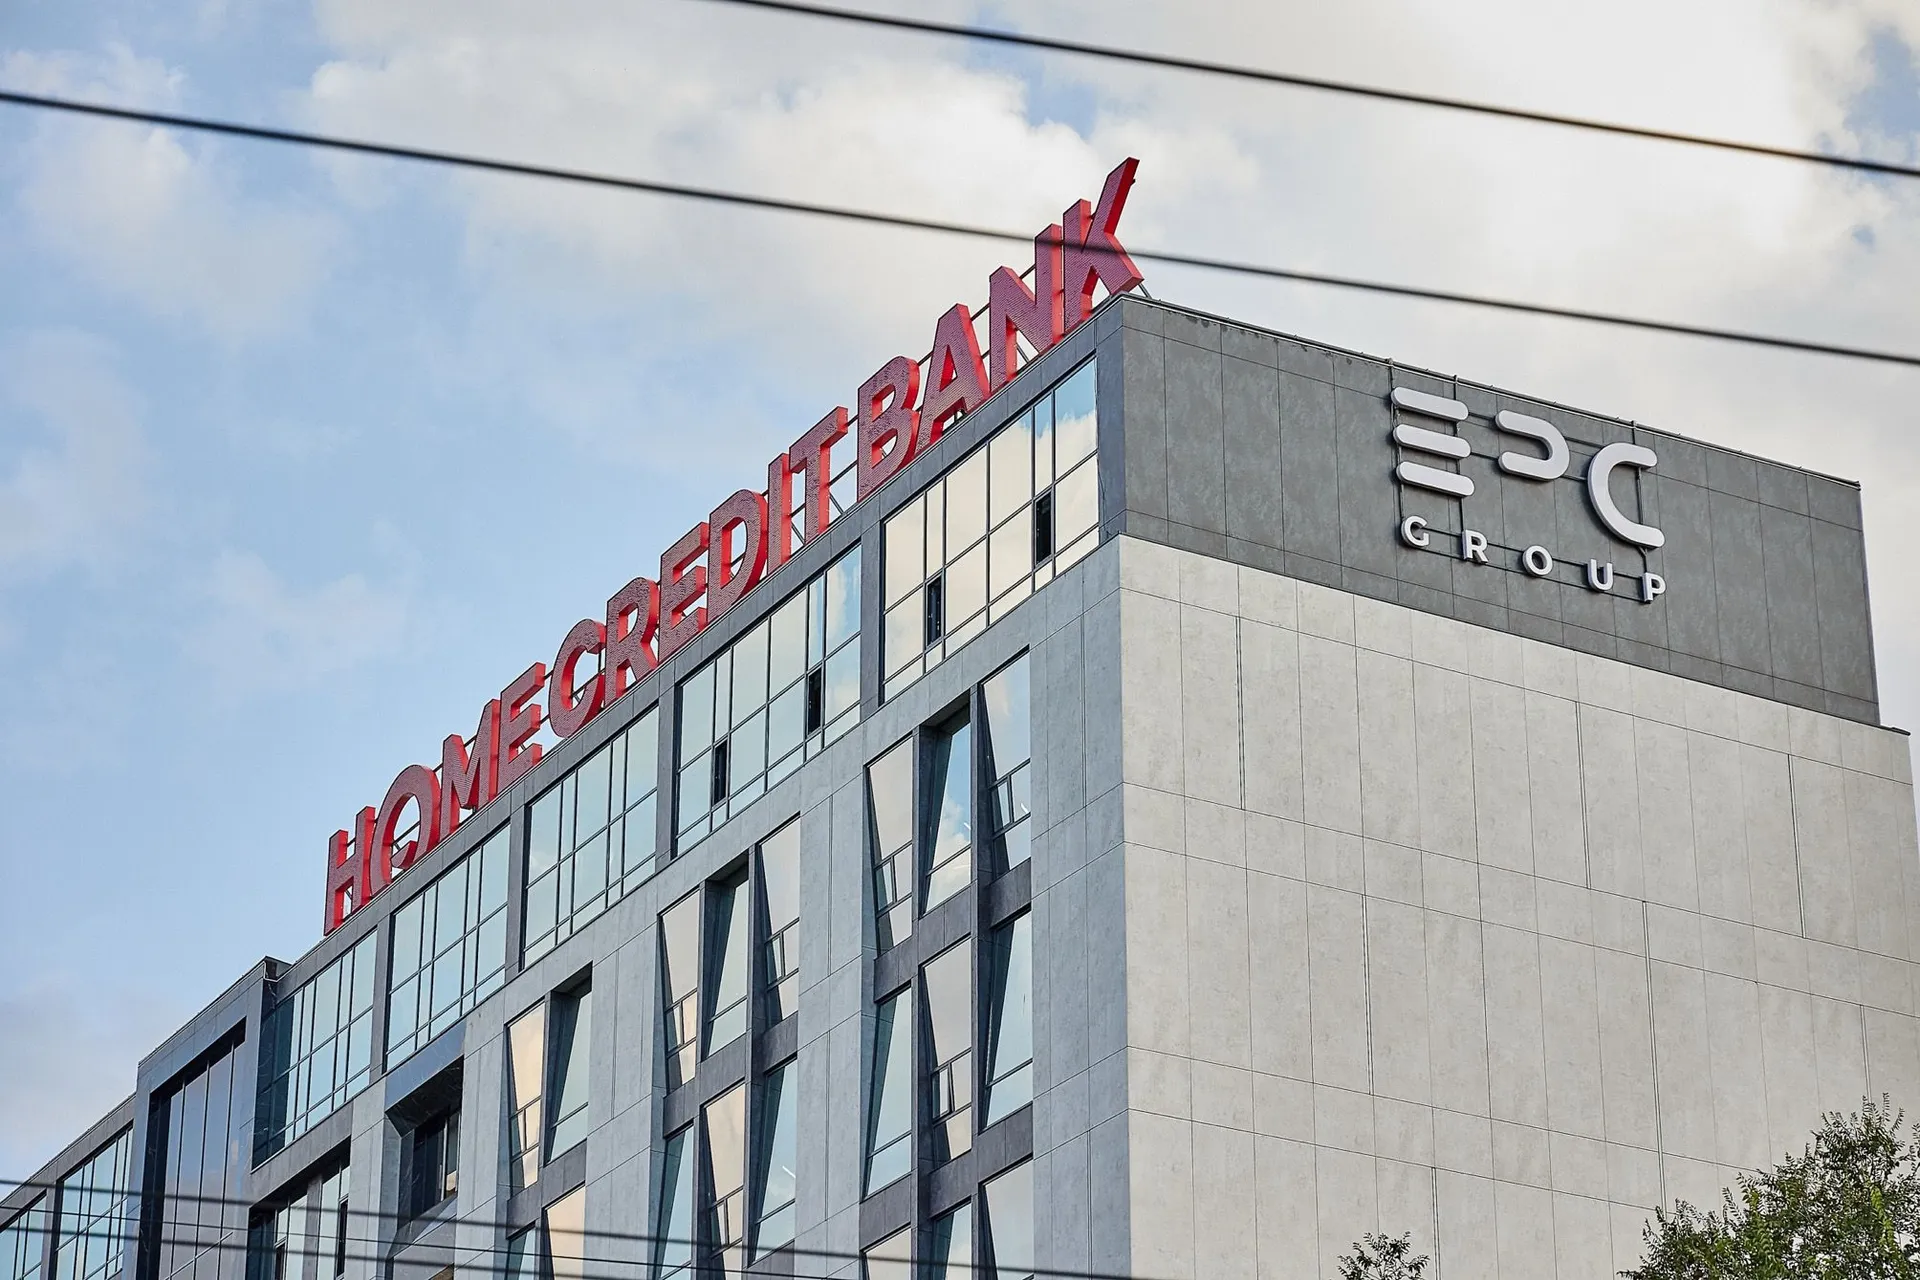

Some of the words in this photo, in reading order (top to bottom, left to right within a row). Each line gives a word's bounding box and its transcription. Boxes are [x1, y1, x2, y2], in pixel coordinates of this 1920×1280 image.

[324, 662, 546, 936] HOME
[549, 406, 848, 738] CREDIT
[857, 156, 1144, 502] BANK
[1401, 515, 1667, 603] GROUP
